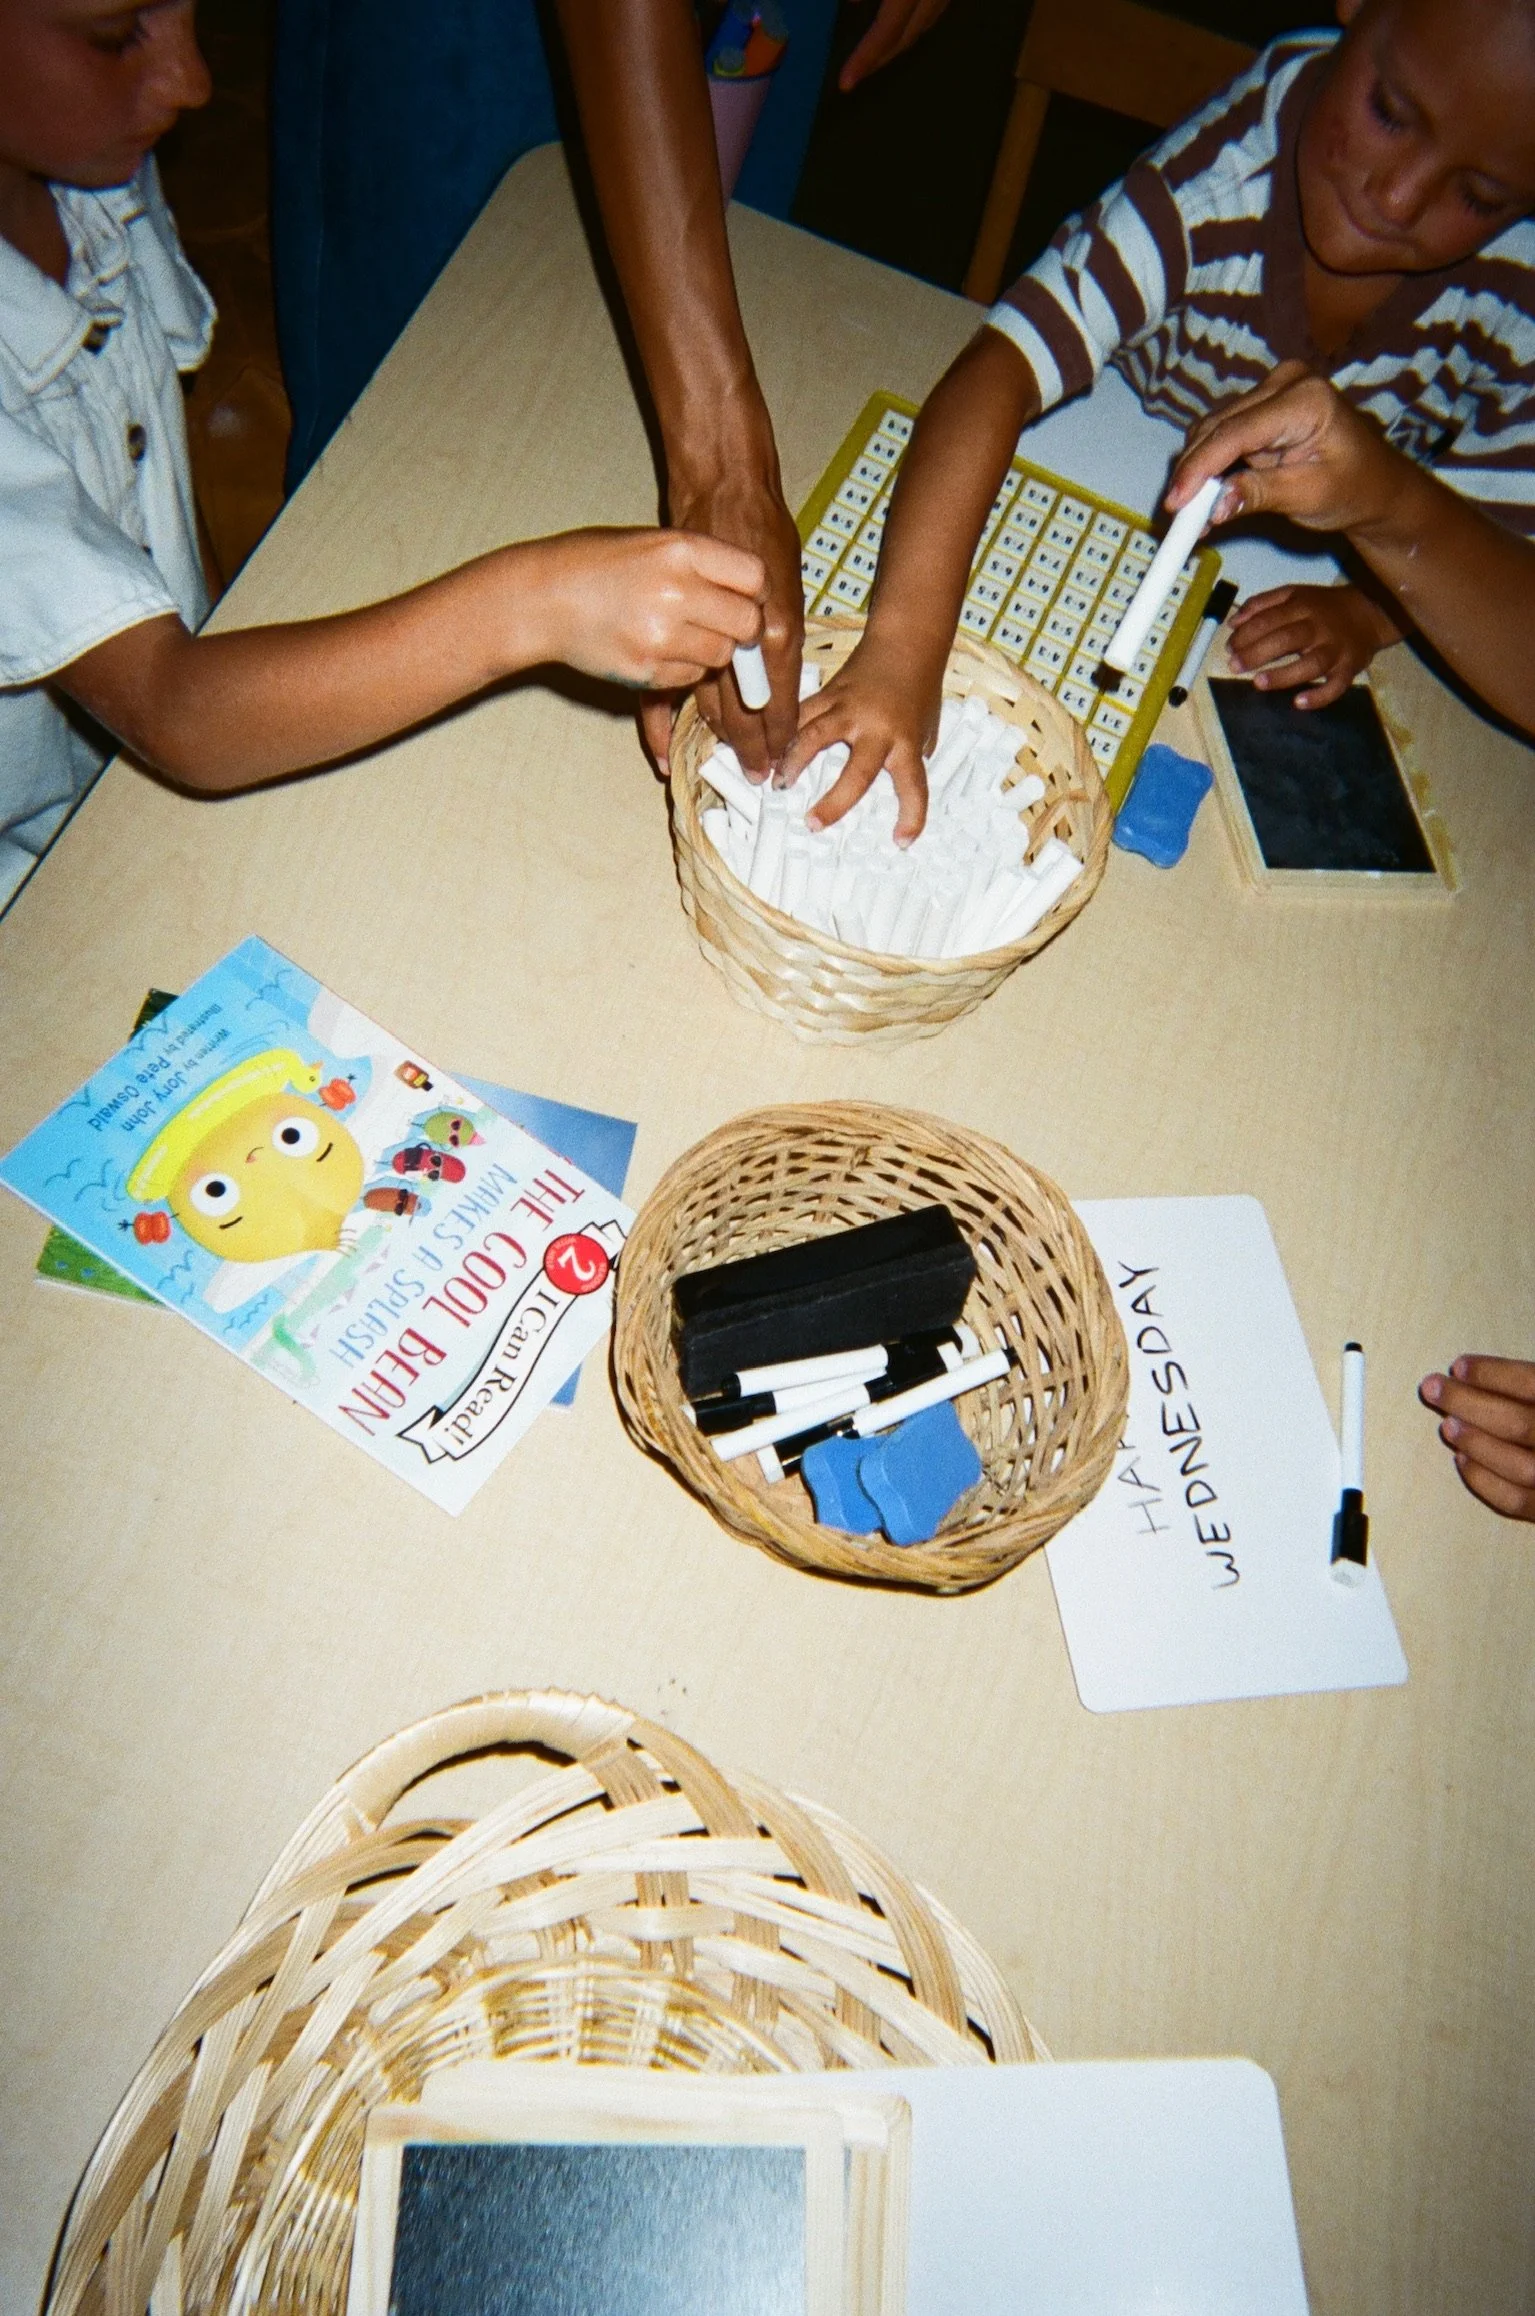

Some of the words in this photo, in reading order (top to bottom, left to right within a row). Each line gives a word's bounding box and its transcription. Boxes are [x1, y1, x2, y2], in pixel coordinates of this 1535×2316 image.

[135, 1056, 171, 1084] Pete
[163, 1043, 180, 1056] by
[183, 1058, 199, 1071] by
[87, 1085, 140, 1132] Oswald
[152, 1071, 187, 1102] Jory
[121, 1100, 156, 1132] John
[433, 1163, 519, 1250] MAKES
[509, 1169, 586, 1232] THE
[412, 1245, 443, 1272] A
[422, 1232, 527, 1328] COOL
[557, 1245, 597, 1282] 2
[329, 1269, 425, 1368] SPLASH
[535, 1288, 561, 1308] I
[502, 1306, 547, 1360] Can
[338, 1327, 447, 1437] BEAN
[444, 1364, 518, 1446] Read!
[1118, 1261, 1240, 1589] WEDNESDAY
